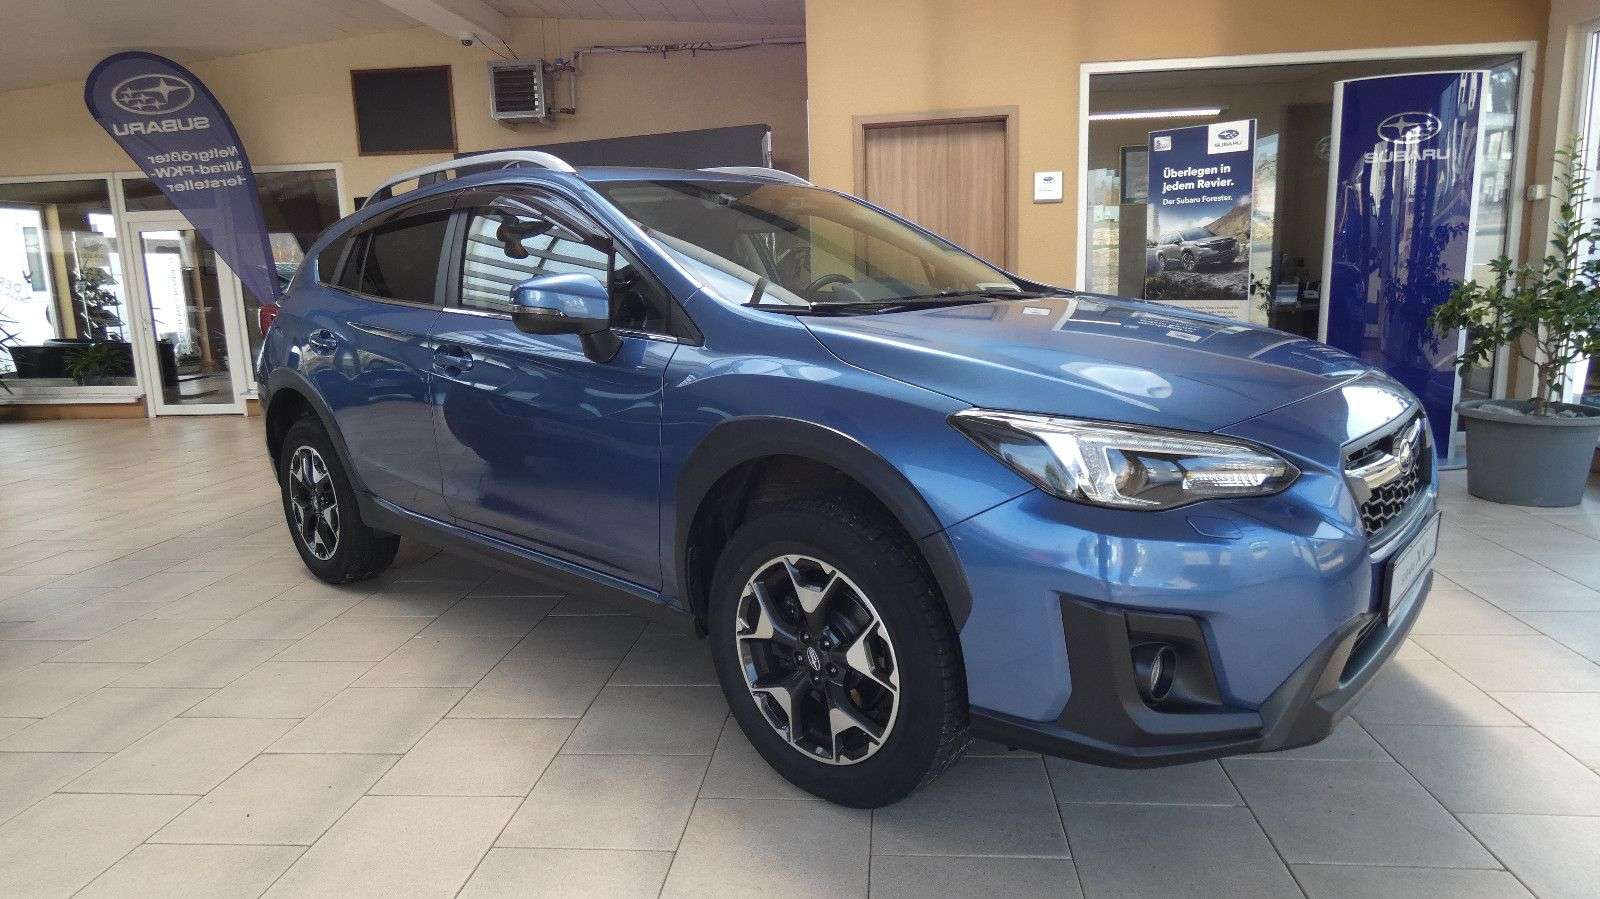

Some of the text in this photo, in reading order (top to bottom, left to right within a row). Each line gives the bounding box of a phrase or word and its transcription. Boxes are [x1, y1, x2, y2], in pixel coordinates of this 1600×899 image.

[1364, 148, 1450, 164] SUBARU
[1163, 163, 1231, 179] Überlegen in
[1162, 178, 1234, 194] jedem Revier.
[1162, 194, 1233, 206] Der Subaru Forester.
